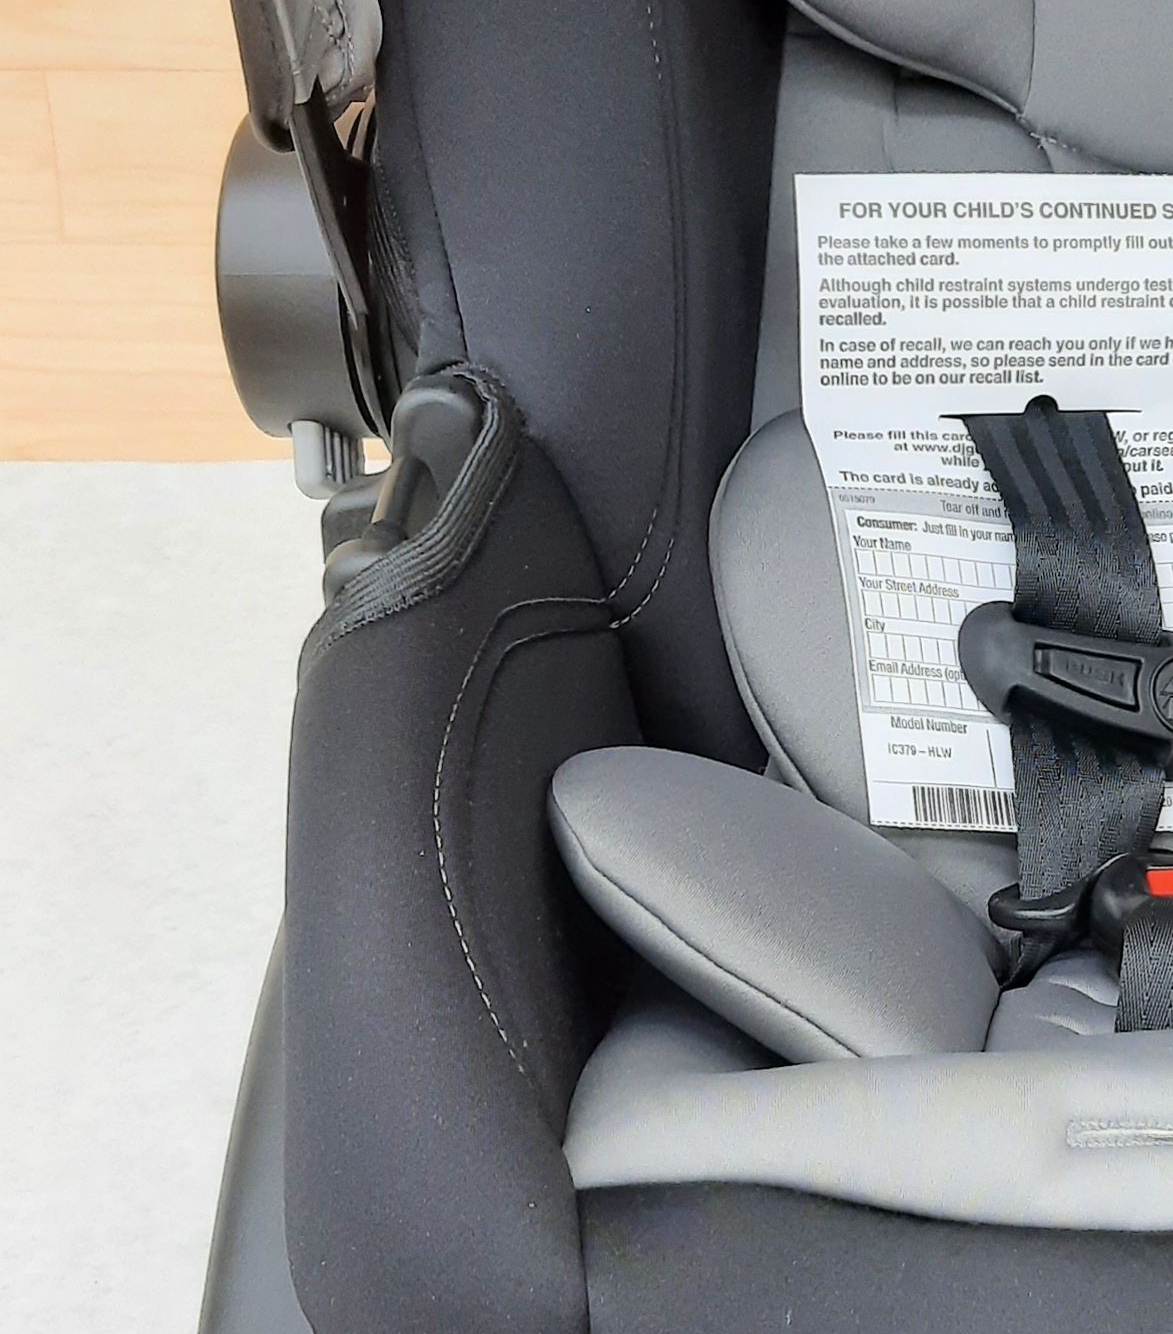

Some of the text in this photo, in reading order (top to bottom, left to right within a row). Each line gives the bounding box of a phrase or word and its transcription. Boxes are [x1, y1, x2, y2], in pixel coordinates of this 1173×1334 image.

[839, 202, 883, 219] FOR
[888, 202, 947, 219] YOUR
[953, 202, 1034, 219] CHILD'S
[1039, 202, 1157, 219] CONTINUED
[818, 235, 870, 249] Please
[875, 235, 908, 249] take
[912, 239, 921, 249] a
[926, 235, 953, 249] few
[958, 237, 1029, 249] moments
[1033, 236, 1048, 249] to
[1053, 236, 1121, 252] promptly
[1125, 236, 1144, 249] fill
[1149, 237, 1173, 249] out
[818, 252, 960, 265] the attached card.
[819, 278, 892, 295] Although
[896, 278, 934, 292] child
[939, 278, 1004, 292] restraint
[1007, 280, 1071, 295] systems
[1076, 278, 1140, 294] undergo
[819, 295, 905, 311] evaluation,
[909, 296, 920, 308] it
[924, 296, 938, 308] is
[942, 295, 1008, 312] possible
[1012, 295, 1042, 308] that
[1046, 298, 1055, 308] a
[1059, 295, 1096, 308] child
[1101, 295, 1165, 308] restraint
[819, 312, 887, 326] recalled.
[820, 339, 834, 352] In
[839, 341, 876, 352] case
[880, 338, 896, 351] of
[900, 338, 946, 353] recall,
[950, 340, 973, 351] we
[977, 340, 1004, 351] can
[1009, 337, 1050, 351] reach
[1056, 340, 1084, 353] you
[1089, 337, 1121, 353] only
[1126, 336, 1136, 350] if
[1140, 339, 1160, 349] we
[821, 357, 863, 369] name
[868, 355, 896, 369] and
[900, 354, 967, 369] address,
[971, 357, 989, 367] so
[994, 353, 1045, 370] please
[1050, 354, 1085, 366] send
[1090, 354, 1104, 366] in
[1109, 353, 1133, 366] the
[1136, 353, 1169, 365] card
[820, 370, 1044, 387] online to be on our recall list.
[833, 431, 883, 440] Please
[888, 431, 906, 440] fill
[910, 431, 939, 441] this
[1133, 431, 1149, 442] or
[894, 442, 908, 452] at
[941, 455, 979, 468] while
[839, 470, 869, 483] The
[873, 472, 906, 484] card
[910, 473, 924, 486] is
[927, 474, 979, 493] already
[1141, 481, 1173, 498] paid
[940, 499, 961, 513] Tear
[966, 502, 979, 515] off
[982, 506, 1000, 518] and
[857, 516, 918, 531] Consumer:
[922, 521, 943, 535] Just
[946, 523, 957, 536] fill
[959, 525, 968, 536] in
[971, 526, 991, 541] your
[853, 535, 911, 550] Your Name
[859, 577, 959, 598] Your Street Address
[865, 618, 885, 632] City
[869, 659, 899, 673] Email
[901, 662, 943, 678] Address
[891, 716, 967, 734] Model Number
